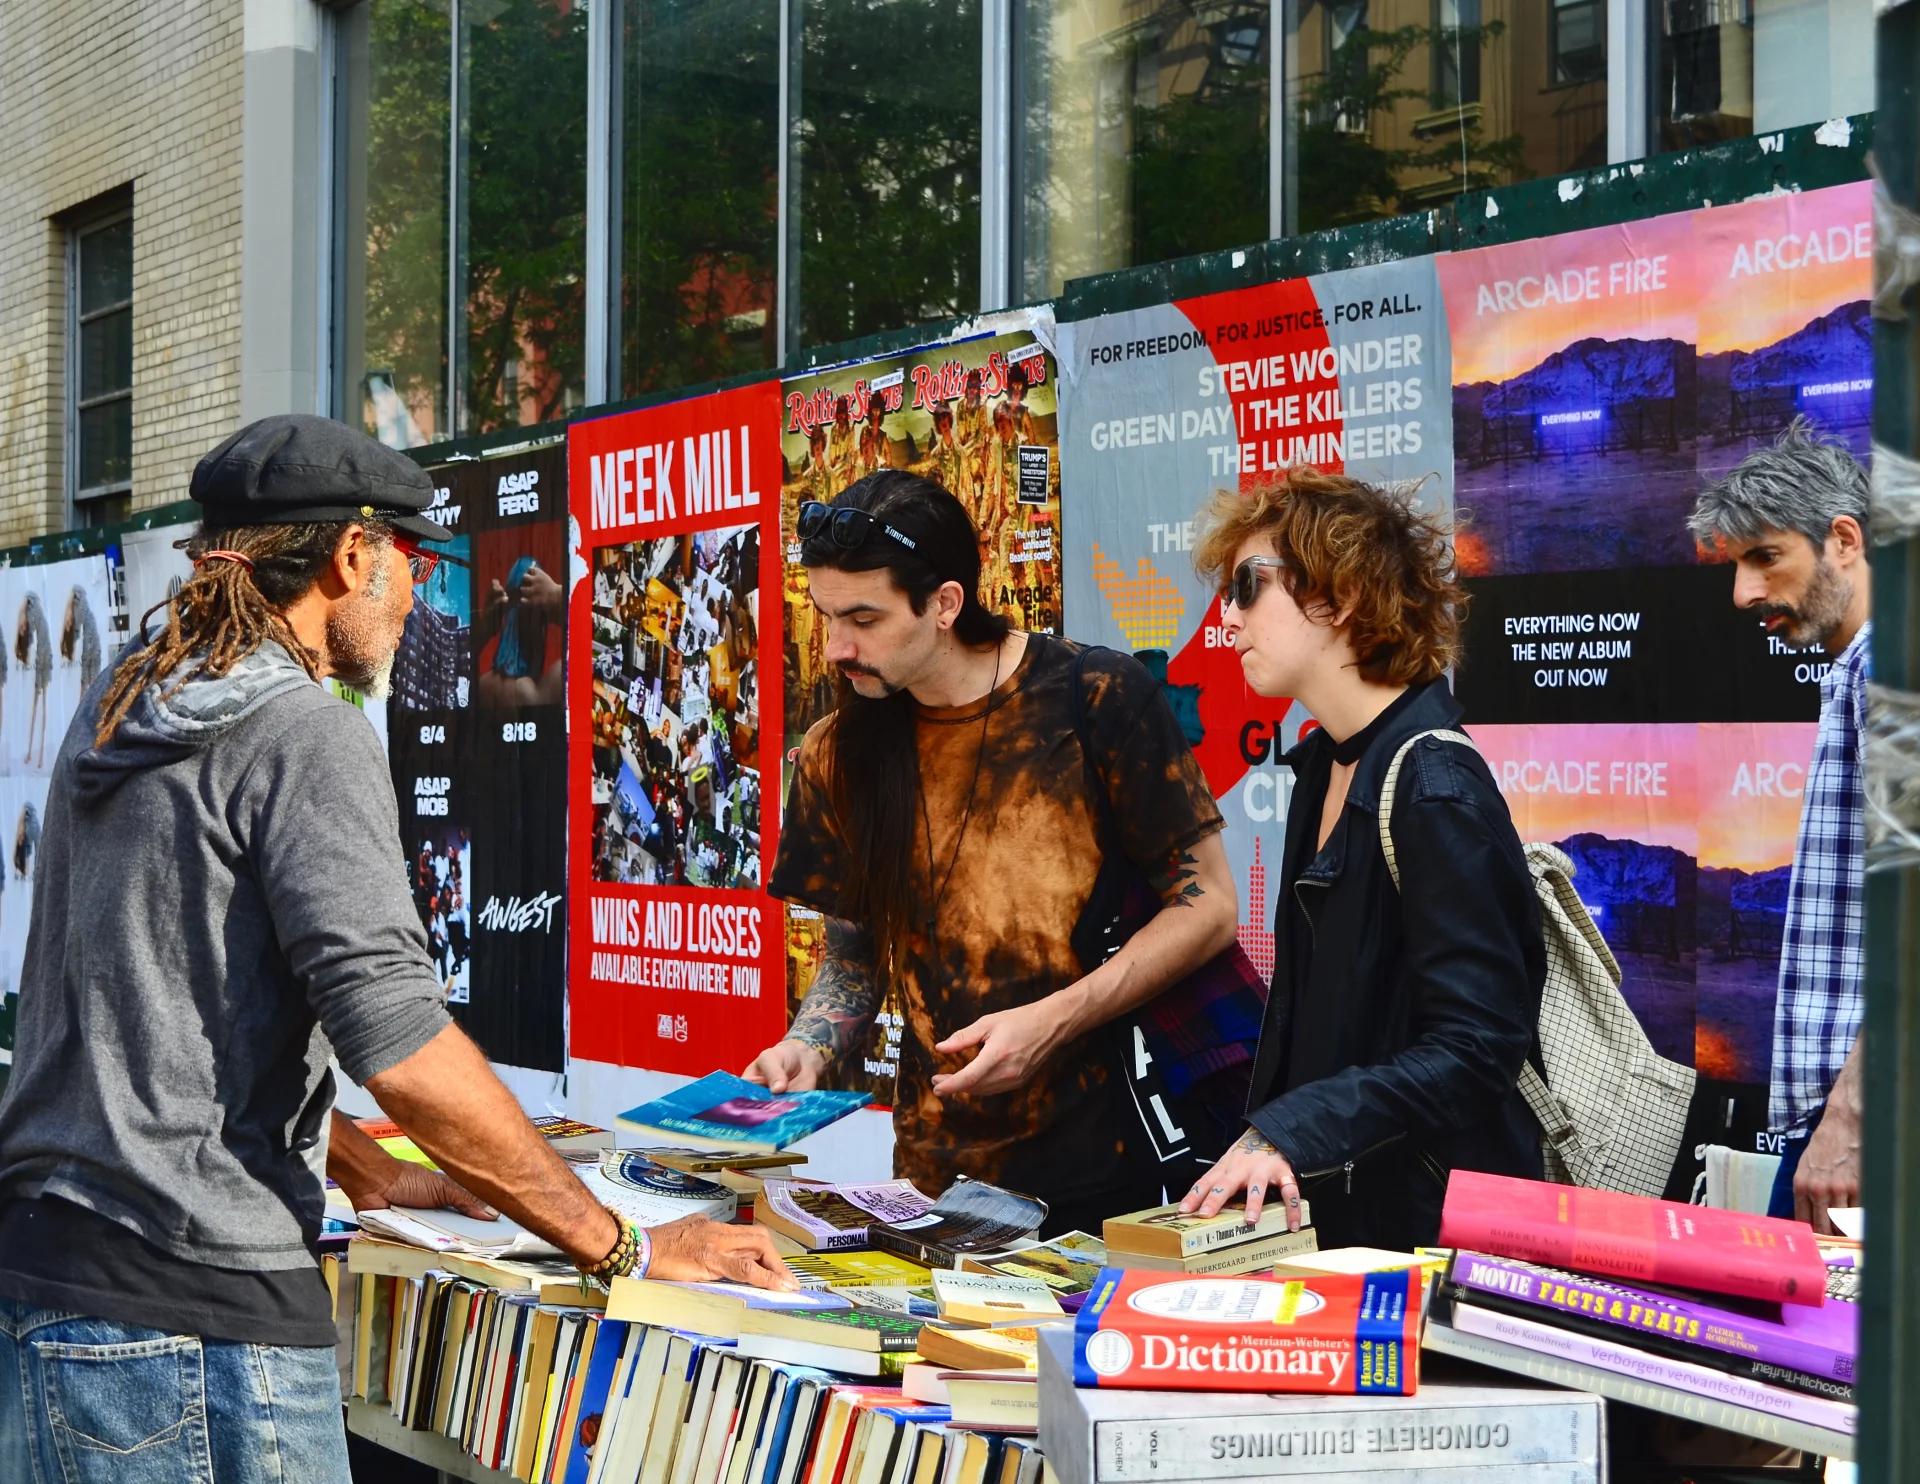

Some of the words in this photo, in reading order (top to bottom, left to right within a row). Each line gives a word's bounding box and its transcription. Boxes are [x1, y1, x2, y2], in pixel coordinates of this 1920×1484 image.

[1730, 222, 1871, 280] ARCADE
[1476, 265, 1600, 316] ARCADE
[1609, 255, 1669, 296] FIRE
[1090, 345, 1122, 365] FOR
[1126, 330, 1212, 360] FREEDOM.
[1216, 322, 1249, 344] FOR
[1252, 308, 1329, 340] JUSTICE.
[1334, 299, 1374, 324] FOR
[1379, 293, 1422, 315] ALL.
[987, 352, 1046, 397] Stne
[1198, 354, 1286, 397] STEVIE
[1289, 334, 1422, 383] WONDER
[1802, 381, 1849, 398] EVERYTHING
[1850, 378, 1872, 392] NOW
[853, 379, 903, 421] Stne
[1090, 412, 1176, 452] GREEN
[1181, 402, 1233, 440] DAY
[1250, 396, 1300, 432] THE
[1306, 377, 1422, 424] KILLERS
[1541, 411, 1581, 426] EVERYTHING
[1581, 409, 1601, 422] NOW
[1021, 453, 1047, 463] TRUMP'S
[1207, 442, 1257, 477] THE
[1262, 421, 1422, 472] LUMINEERS
[590, 440, 677, 530] MEEK
[684, 425, 760, 516] MILL
[427, 487, 450, 509] AP
[498, 492, 539, 517] FERG
[1015, 530, 1026, 540] The
[1026, 529, 1040, 541] very
[1041, 527, 1052, 537] last
[1023, 539, 1050, 551] unheard
[1148, 521, 1197, 553] THE
[1009, 552, 1032, 564] Beatles
[1000, 584, 1052, 606] Arcade
[1023, 604, 1053, 627] Fire
[1504, 613, 1595, 636] EVERYTHING
[1598, 612, 1640, 632] NOW
[1204, 626, 1236, 648] BIG
[1511, 642, 1537, 662] THE
[1540, 642, 1574, 661] NEW
[1578, 640, 1632, 660] ALBUM
[1534, 669, 1564, 688] OUT
[1568, 668, 1608, 687] NOW
[420, 725, 446, 744] 8/4
[502, 722, 537, 742] 8/18
[1609, 762, 1669, 797] FIRE
[1731, 762, 1803, 799] ARC
[416, 797, 448, 816] MOB
[590, 897, 640, 947] WINS
[644, 901, 683, 950] AND
[687, 903, 761, 958] LOSSES
[590, 952, 650, 986] AVAILABLE
[652, 957, 729, 995] EVERYWHERE
[732, 965, 761, 998] NOW
[864, 1057, 896, 1078] buying
[1756, 1132, 1786, 1153] EVE
[827, 1233, 866, 1247] PERSONAL
[1216, 1228, 1235, 1241] Thomas
[1490, 1228, 1537, 1242] ROBERT
[1196, 1257, 1246, 1274] KIERKEGAARD
[1251, 1246, 1289, 1261] EITHER/OR
[1577, 1240, 1651, 1260] INNERLIJKE
[1575, 1254, 1645, 1273] REVOLUTIE
[1467, 1262, 1532, 1295] MOVIE
[1538, 1281, 1605, 1314] FACTS
[1609, 1301, 1624, 1318] &
[1628, 1304, 1699, 1338] FEATS
[1495, 1322, 1519, 1336] Rudy
[1707, 1325, 1744, 1340] PATRICK
[1240, 1334, 1350, 1349] Merriam-Webster's
[1705, 1333, 1758, 1352] ROBERTSON
[1140, 1334, 1350, 1385] Dictionary
[1590, 1346, 1664, 1377] Verborgen
[1668, 1368, 1792, 1410] verwantschappen
[1793, 1371, 1851, 1398] Hitchcock
[1526, 1355, 1606, 1393] CLASSIC
[1621, 1379, 1707, 1418] FOREIGN
[1720, 1407, 1780, 1437] FILMS
[1209, 1429, 1355, 1460] BUILDINGS
[1367, 1423, 1509, 1453] CONCRETE
[1115, 1430, 1123, 1472] TASCHEN
[1150, 1461, 1157, 1469] 2
